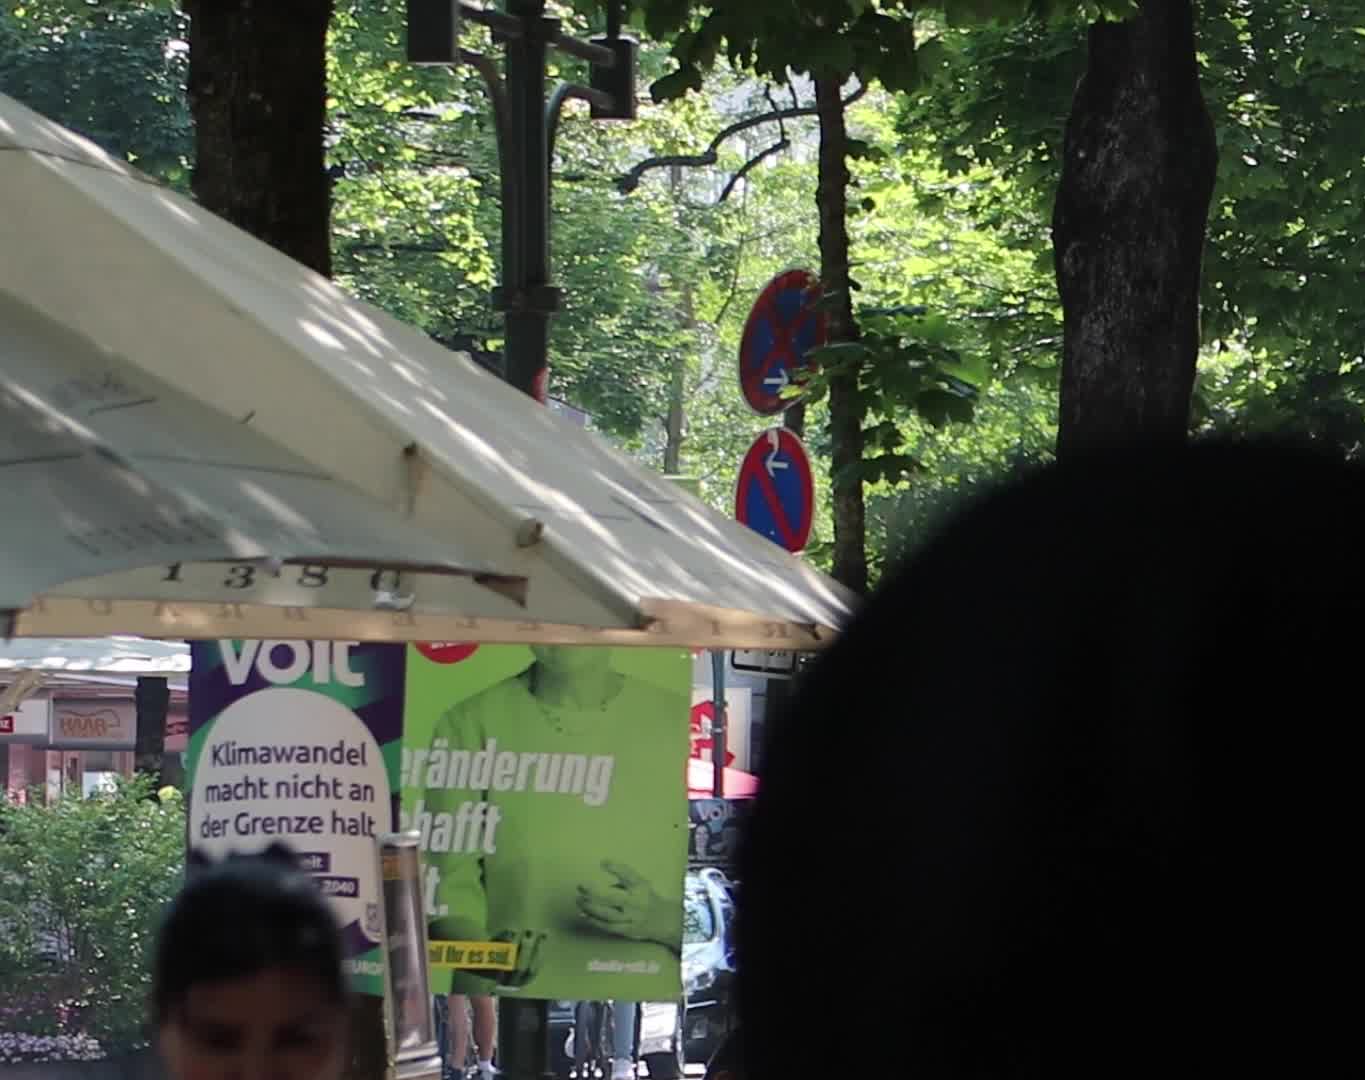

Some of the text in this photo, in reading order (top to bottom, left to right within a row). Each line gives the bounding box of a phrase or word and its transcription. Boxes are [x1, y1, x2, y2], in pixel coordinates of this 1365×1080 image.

[210, 740, 369, 768] Klimawandel
[401, 737, 615, 806] ränderung
[204, 773, 375, 803] macht nicht an
[201, 809, 376, 838] der Grenze halt
[400, 799, 500, 855] hafft
